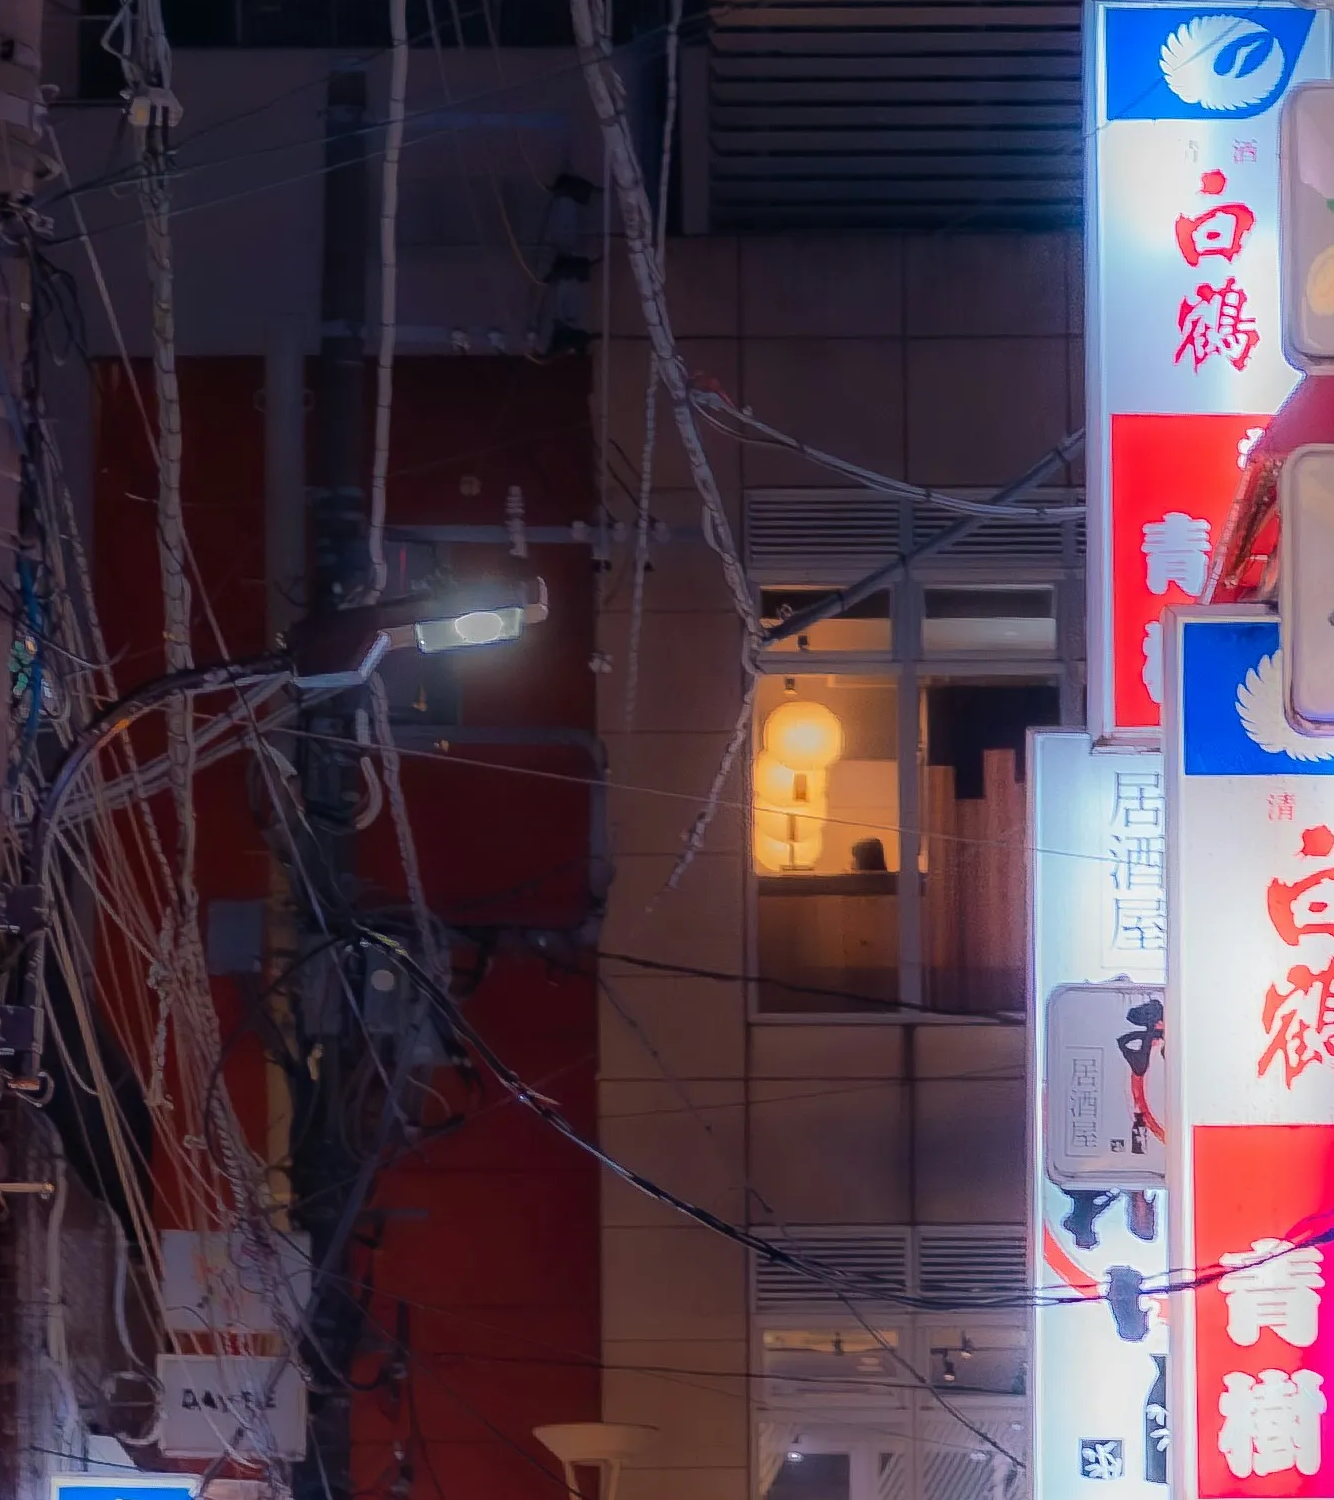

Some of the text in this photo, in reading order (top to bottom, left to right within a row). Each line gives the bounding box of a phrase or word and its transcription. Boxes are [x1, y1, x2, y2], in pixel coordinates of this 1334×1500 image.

[1173, 168, 1258, 374] 白鶴
[1110, 771, 1166, 951] 居酒屋
[1070, 1058, 1101, 1149] 居酒屋
[1216, 1236, 1328, 1479] 青樹
